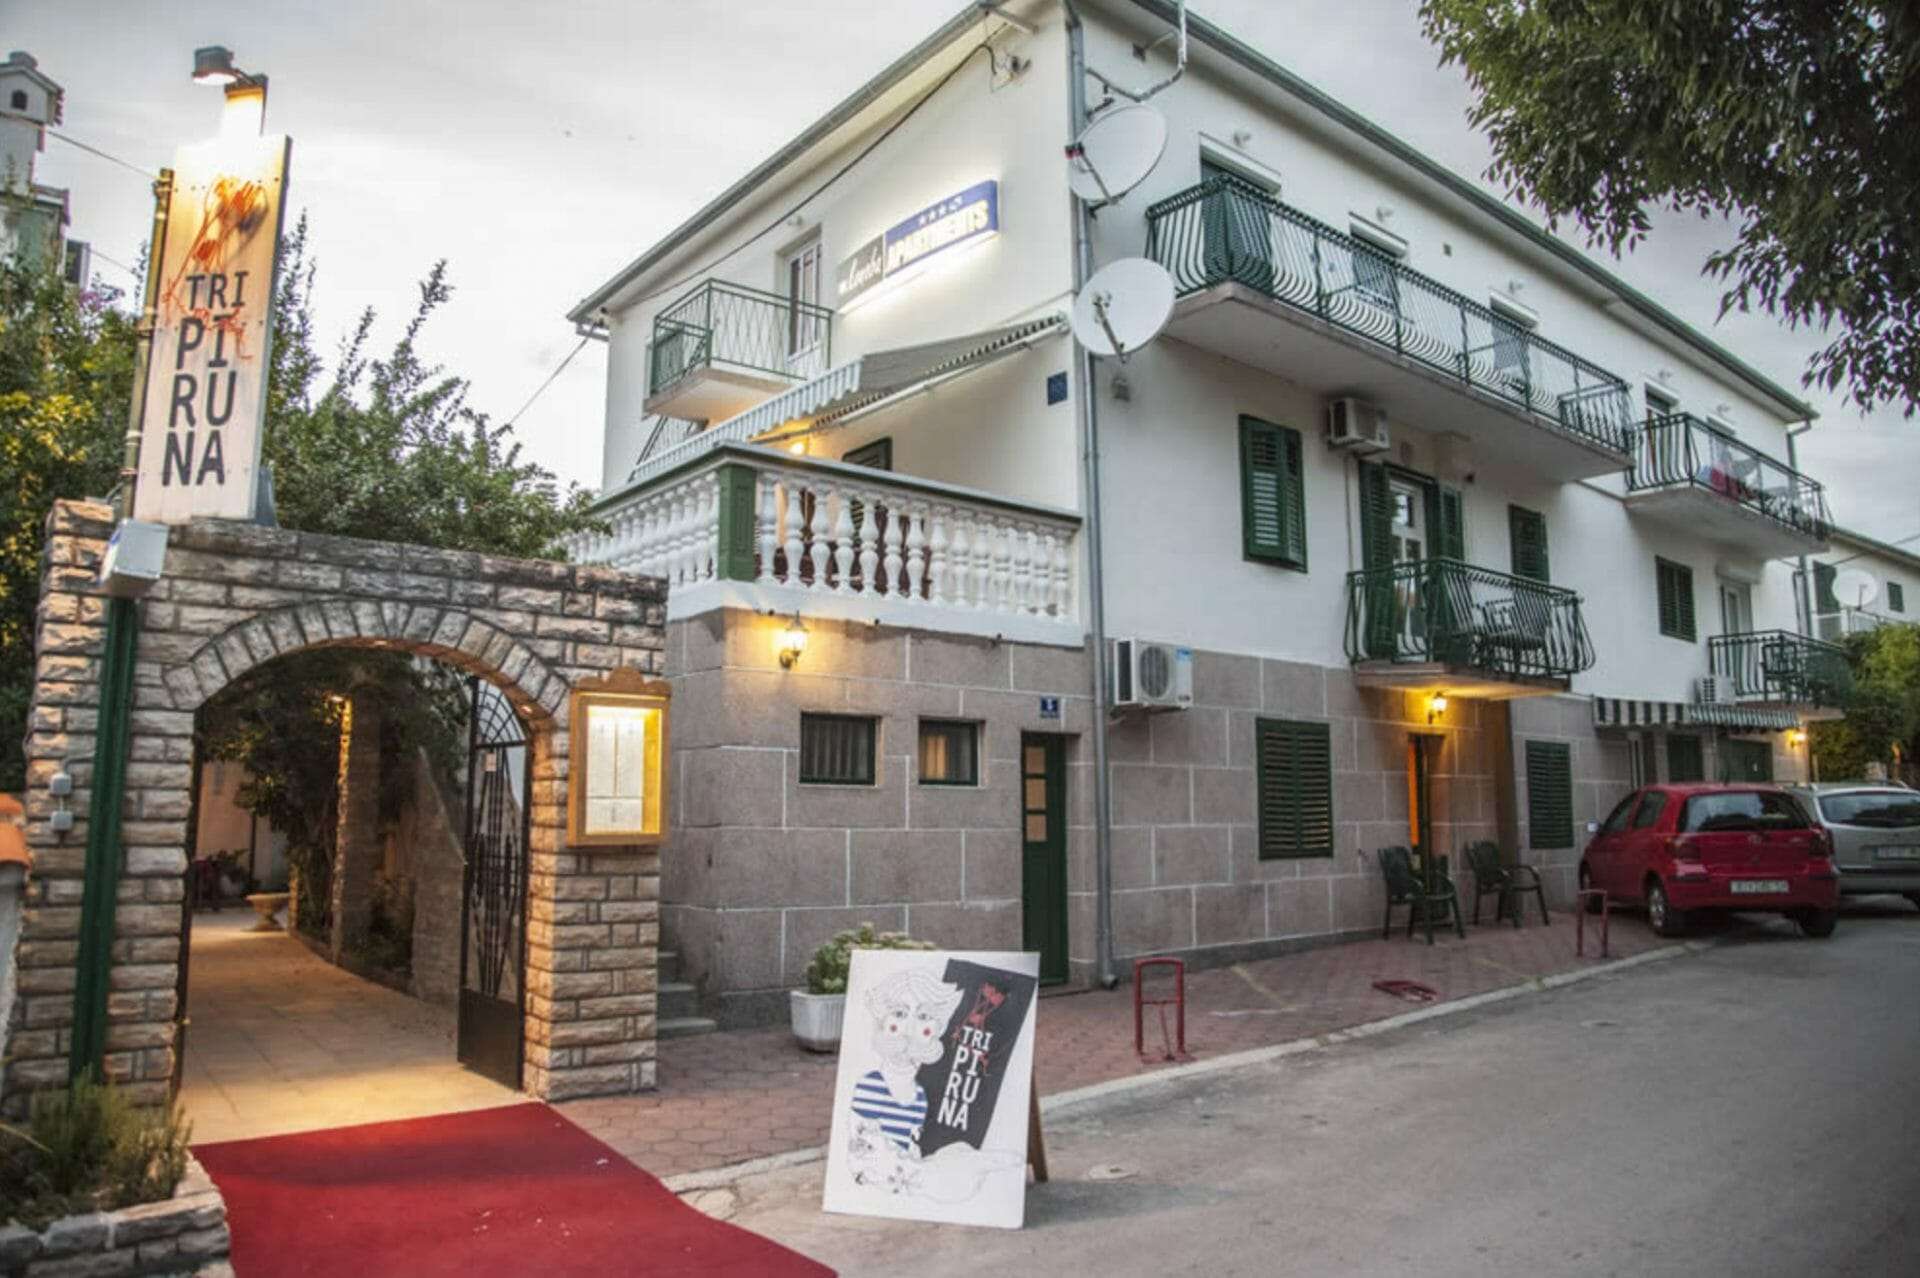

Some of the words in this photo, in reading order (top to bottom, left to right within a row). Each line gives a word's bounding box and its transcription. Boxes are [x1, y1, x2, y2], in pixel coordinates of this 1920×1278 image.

[185, 271, 249, 310] TRI
[176, 314, 233, 370] PI
[169, 372, 237, 428] RU
[162, 430, 226, 486] NA
[962, 1026, 993, 1050] TRI
[952, 1045, 983, 1076] PI
[945, 1073, 980, 1103] RU
[937, 1098, 968, 1131] NA
